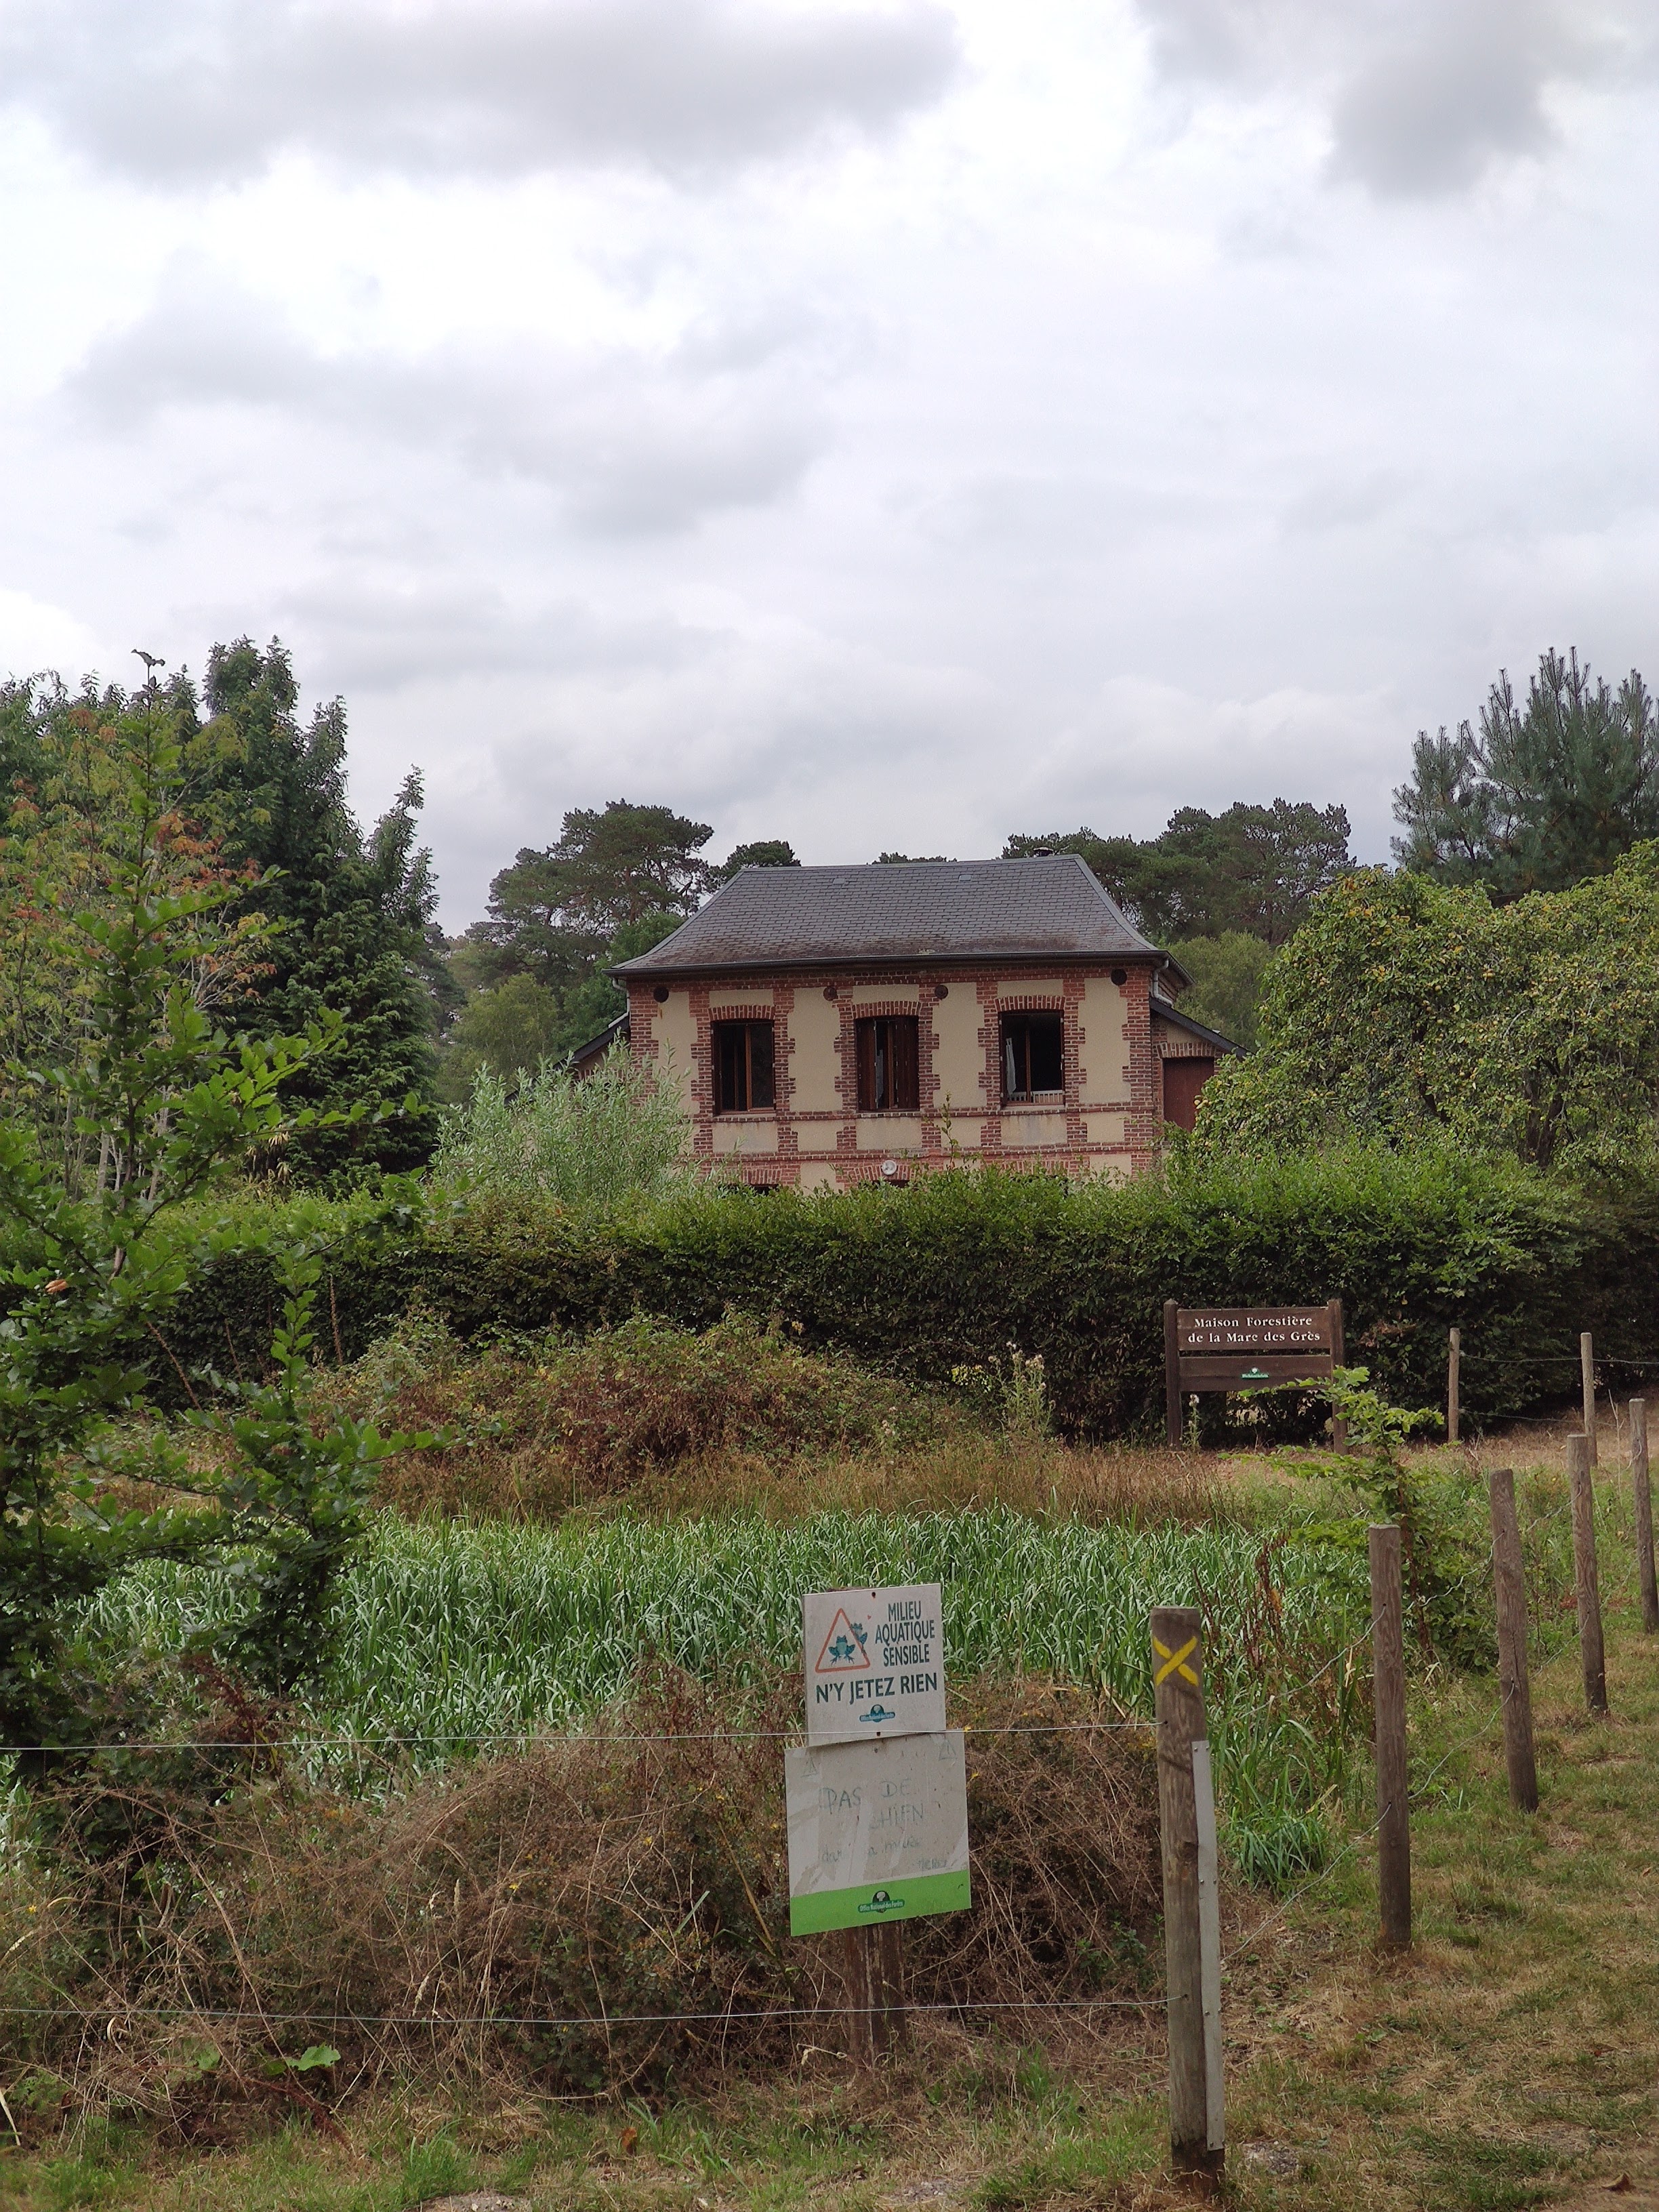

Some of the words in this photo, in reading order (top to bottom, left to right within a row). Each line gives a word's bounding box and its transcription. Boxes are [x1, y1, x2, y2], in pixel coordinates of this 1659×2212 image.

[1194, 1317, 1239, 1328] Maison
[1246, 1316, 1312, 1326] Forestière
[1188, 1332, 1204, 1343] de
[1210, 1332, 1220, 1343] la
[1227, 1332, 1258, 1342] Mare
[1263, 1332, 1285, 1341] des
[1290, 1330, 1320, 1340] Grès
[888, 1601, 921, 1622] MILIEU
[875, 1620, 935, 1646] AQUATIQUE
[883, 1644, 929, 1667] SENSIBLE
[816, 1682, 844, 1704] N'Y
[849, 1677, 895, 1705] JETEZ
[901, 1673, 937, 1694] RIEN
[819, 1786, 861, 1814] PAS
[881, 1778, 912, 1798] DE
